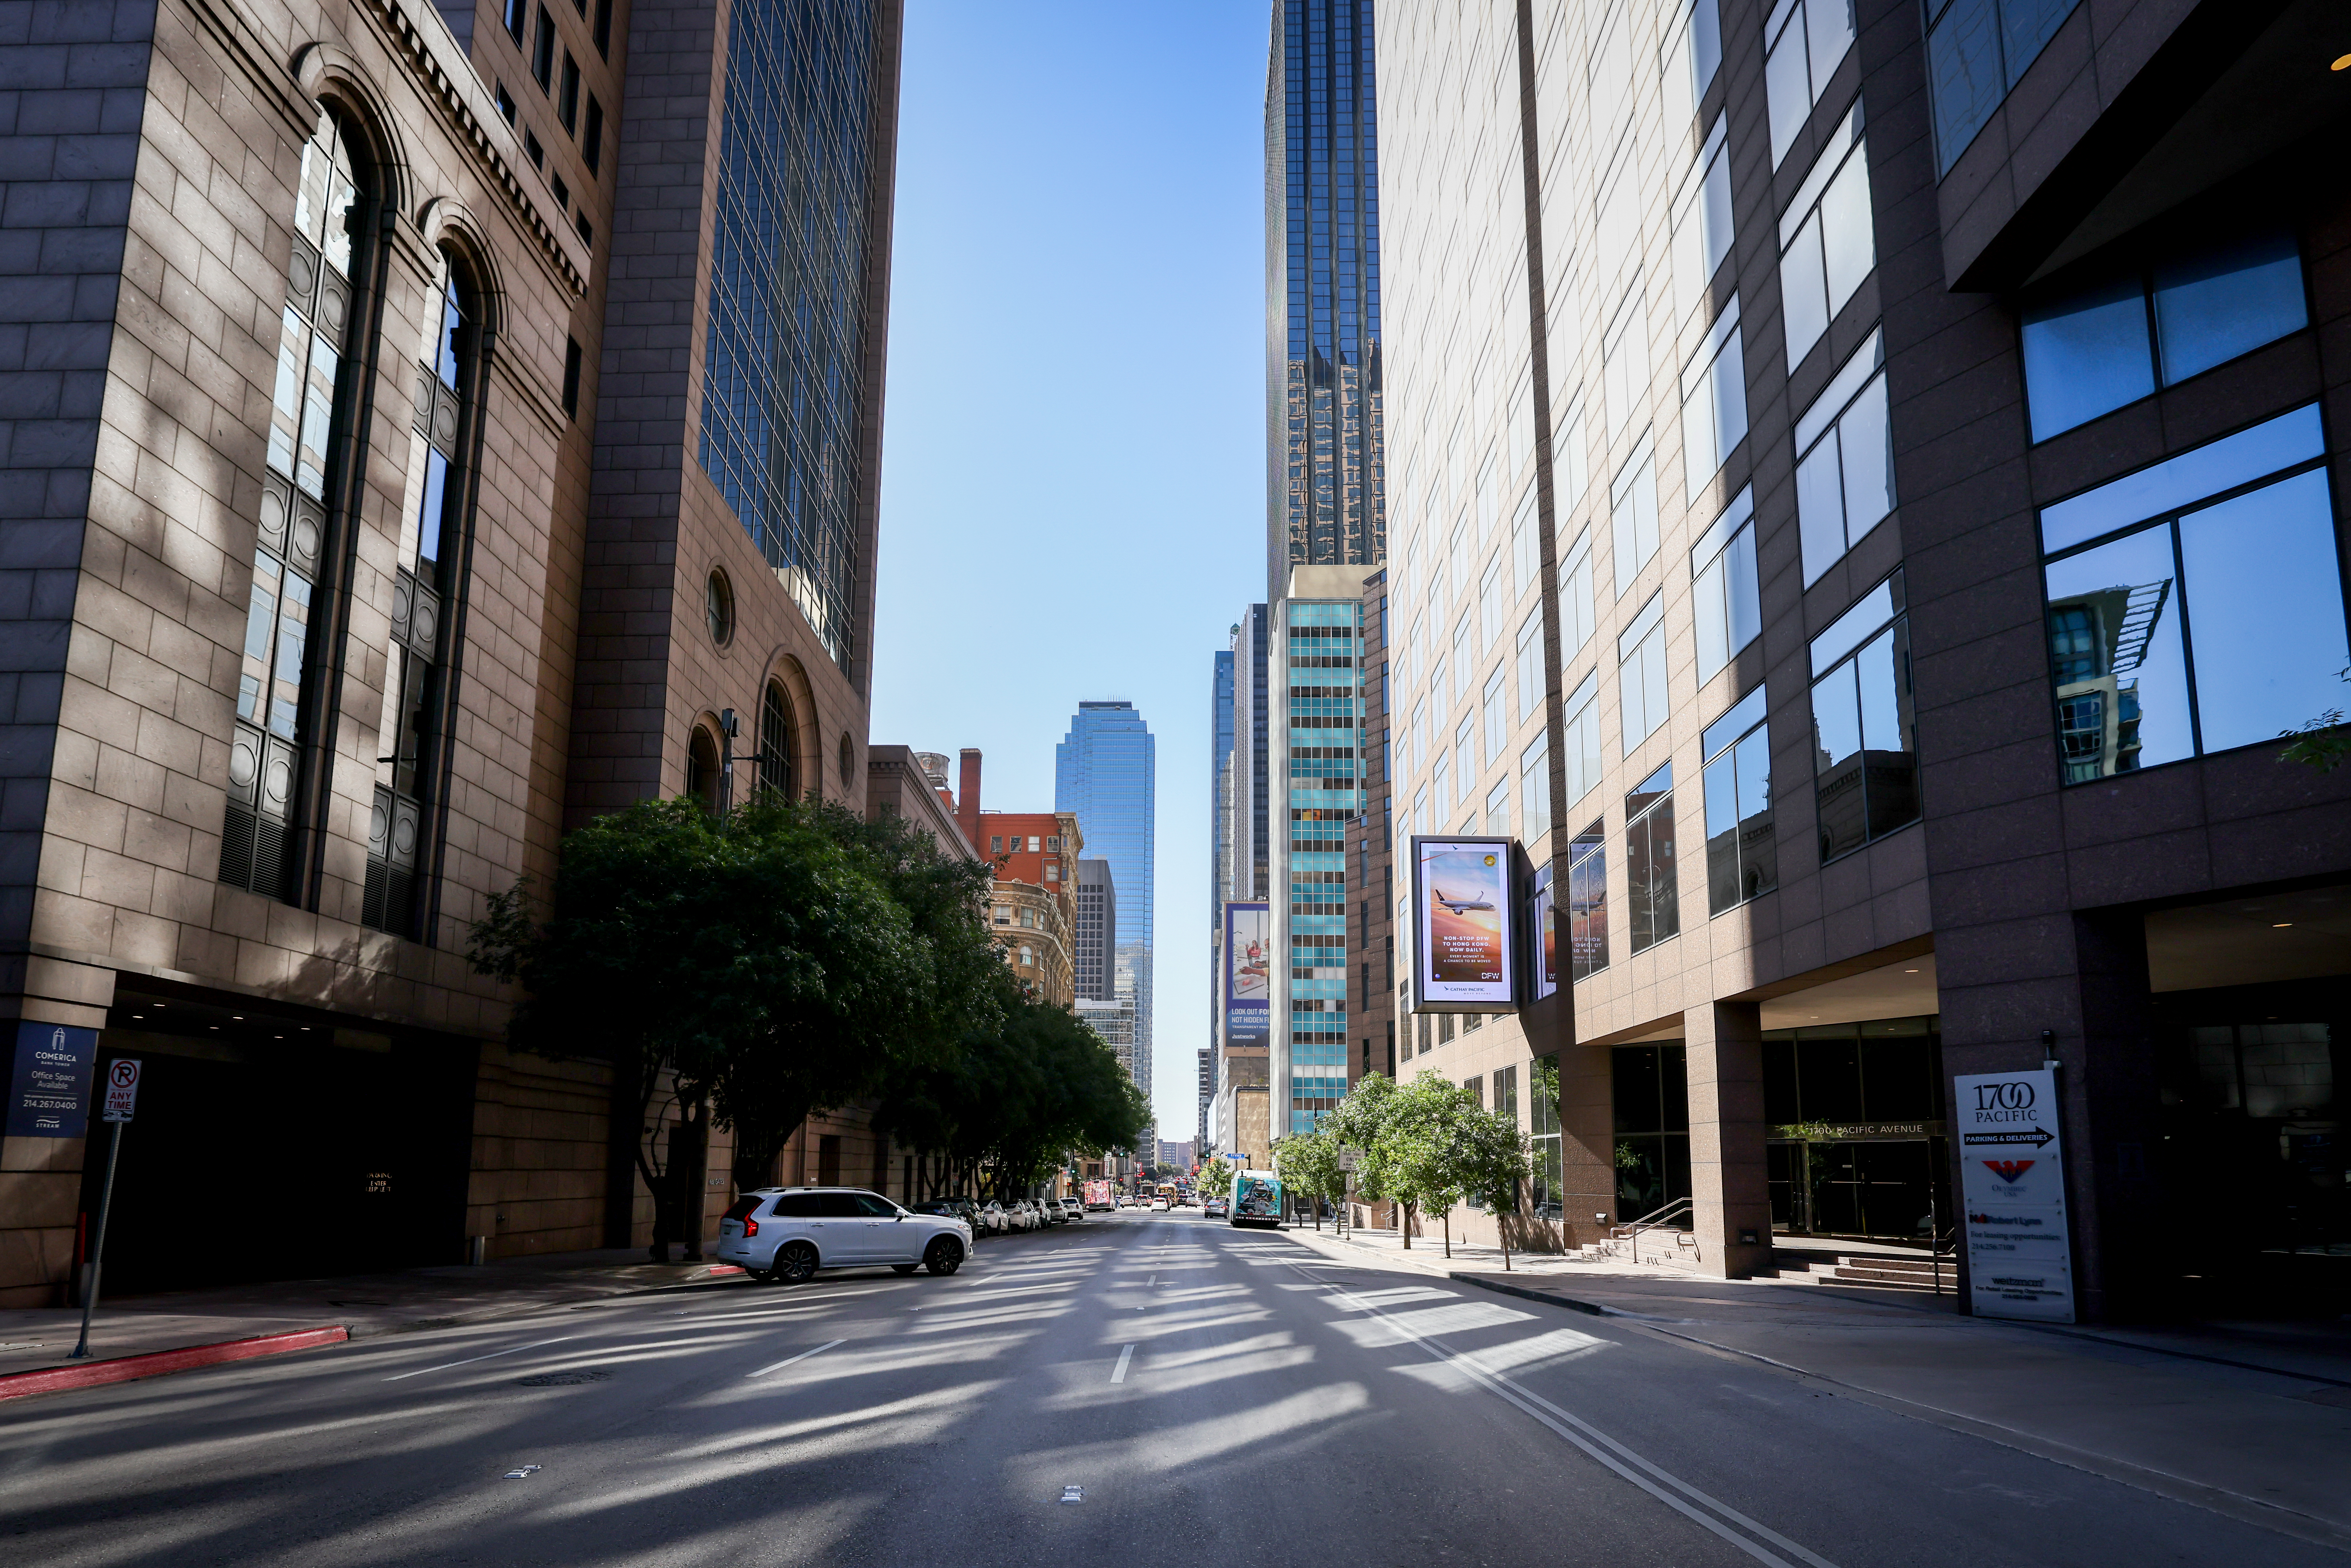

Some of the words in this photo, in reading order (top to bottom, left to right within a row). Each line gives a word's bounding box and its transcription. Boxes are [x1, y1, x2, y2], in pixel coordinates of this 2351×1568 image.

[35, 1051, 76, 1062] COMERICA
[31, 1071, 53, 1079] Office
[55, 1073, 76, 1081] Space
[37, 1081, 68, 1089] Available
[1973, 1082, 2035, 1110] 1700
[23, 1099, 77, 1109] 214.267.0400
[108, 1101, 131, 1109] TIME
[1976, 1110, 2037, 1122] PACIFIC
[1984, 1231, 2008, 1240] leasing
